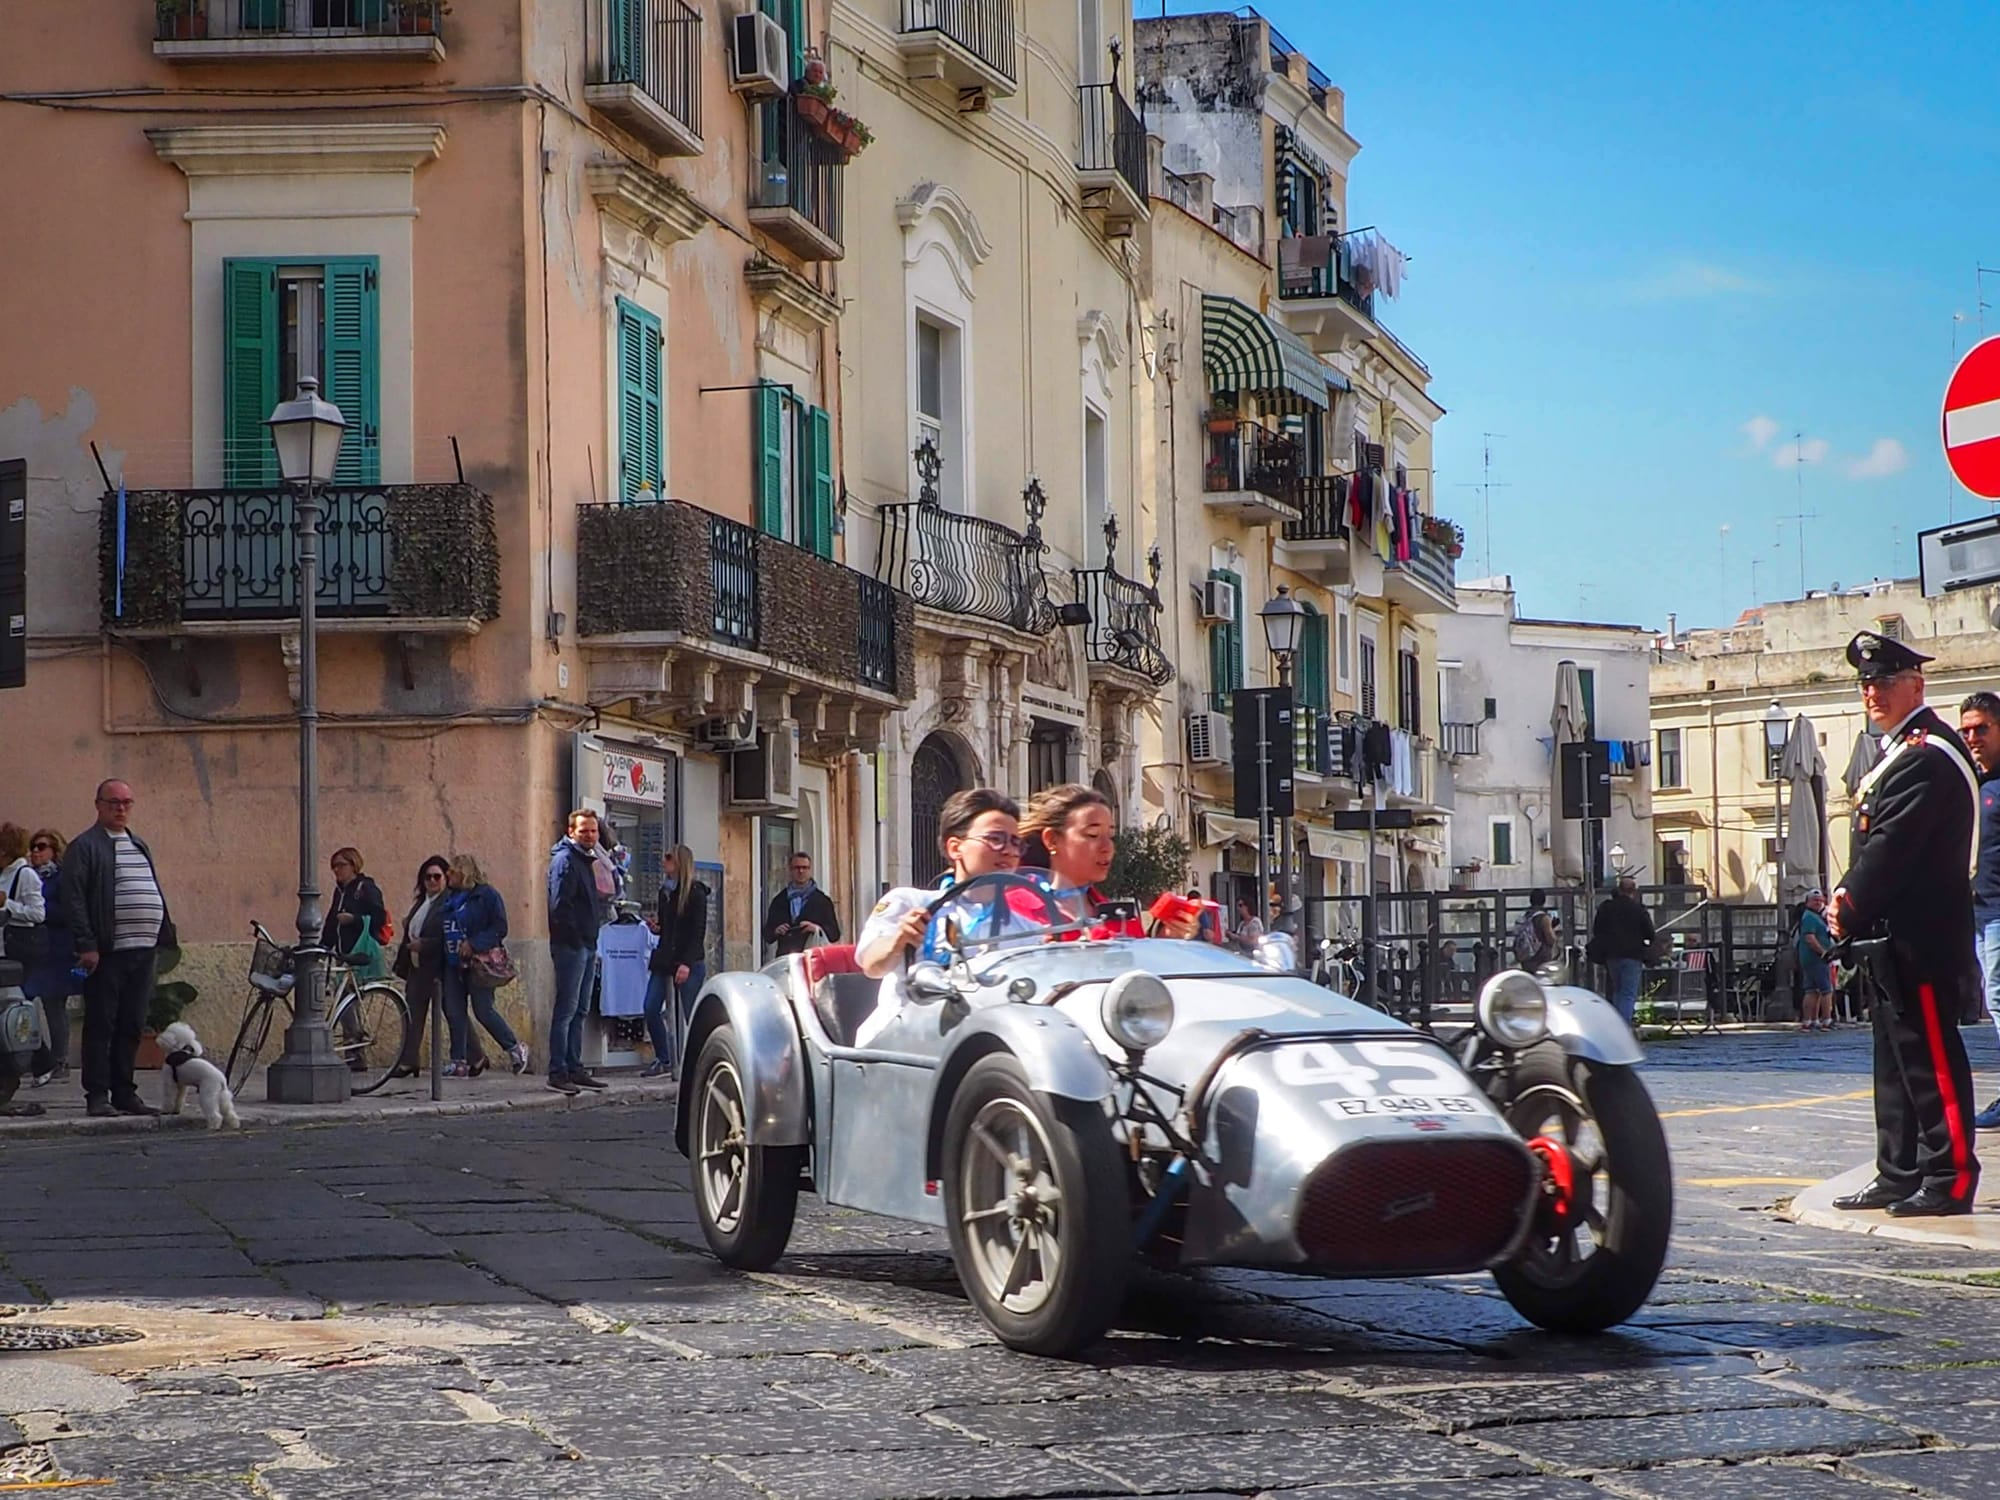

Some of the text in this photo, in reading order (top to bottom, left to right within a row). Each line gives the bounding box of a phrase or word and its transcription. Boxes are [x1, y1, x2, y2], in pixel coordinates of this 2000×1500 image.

[1272, 1041, 1473, 1097] 45
[1337, 1099, 1377, 1115] EZ
[1380, 1097, 1432, 1113] 949
